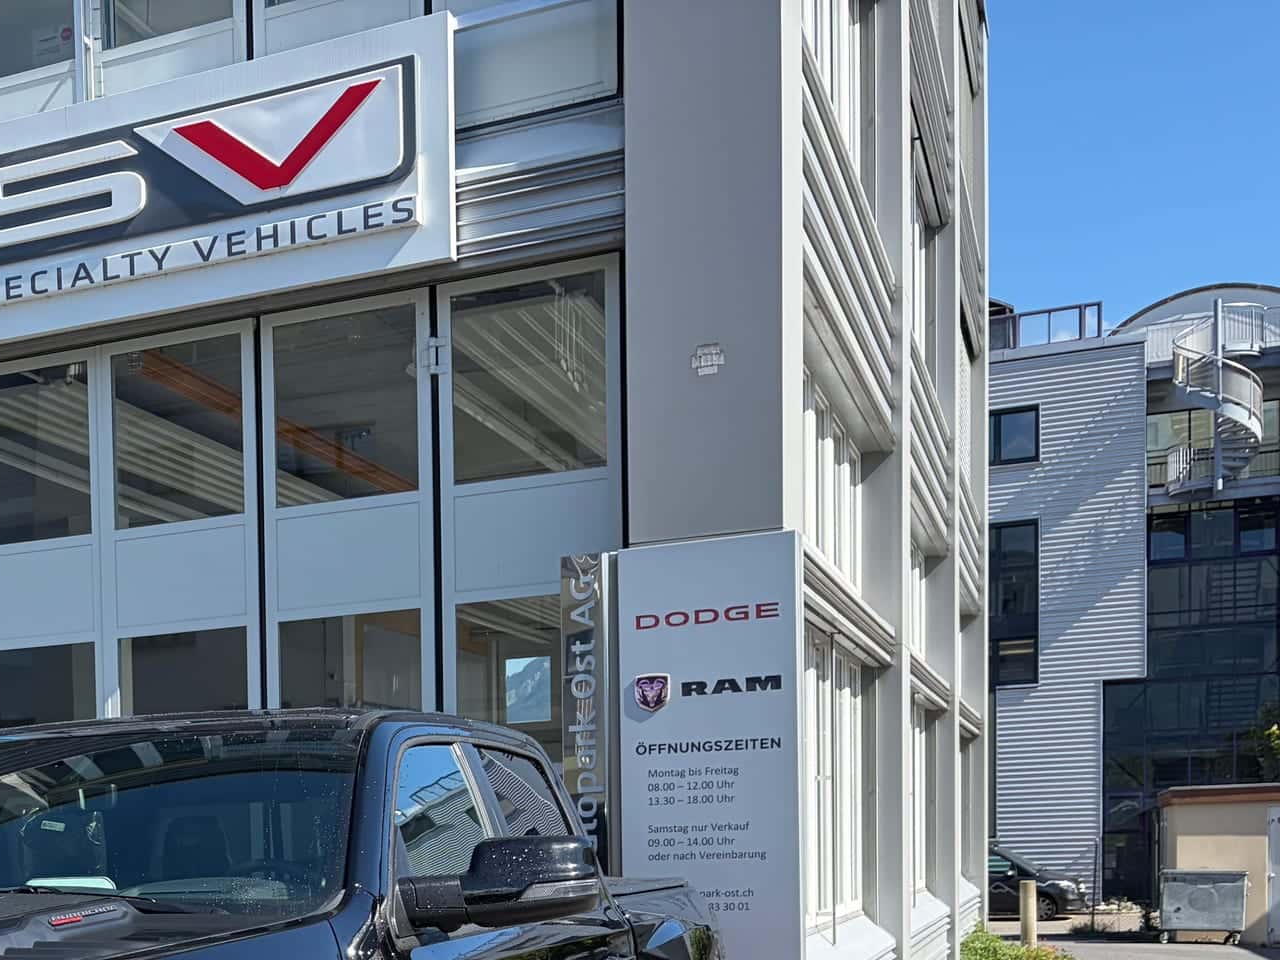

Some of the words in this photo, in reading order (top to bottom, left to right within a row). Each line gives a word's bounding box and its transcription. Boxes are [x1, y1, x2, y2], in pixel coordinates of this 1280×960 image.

[192, 196, 415, 263] VEHICLES
[570, 574, 596, 627] AG
[635, 602, 780, 631] DODGE
[570, 640, 596, 699] Ost
[681, 674, 782, 697] RAM
[635, 737, 782, 756] ÖFFNUNGSZEITEN
[568, 711, 604, 848] topark
[648, 769, 686, 779] Montag
[689, 767, 702, 777] bis
[705, 766, 739, 777] Freitag
[648, 782, 675, 792] 08.00
[687, 781, 714, 791] 12.00
[717, 780, 735, 789] Uhr
[648, 796, 675, 806] 13.30
[687, 795, 714, 804] 18.00
[717, 794, 735, 803] Uhr
[648, 824, 688, 834] Samstag
[710, 821, 749, 831] Verkauf
[648, 838, 675, 847] 09.00
[687, 837, 714, 846] 14.00
[717, 836, 735, 845] Uhr
[648, 851, 670, 861] oder
[673, 851, 696, 860] nach
[699, 850, 767, 861] Vereinbarung
[724, 902, 736, 911] 30
[738, 902, 750, 911] 01
